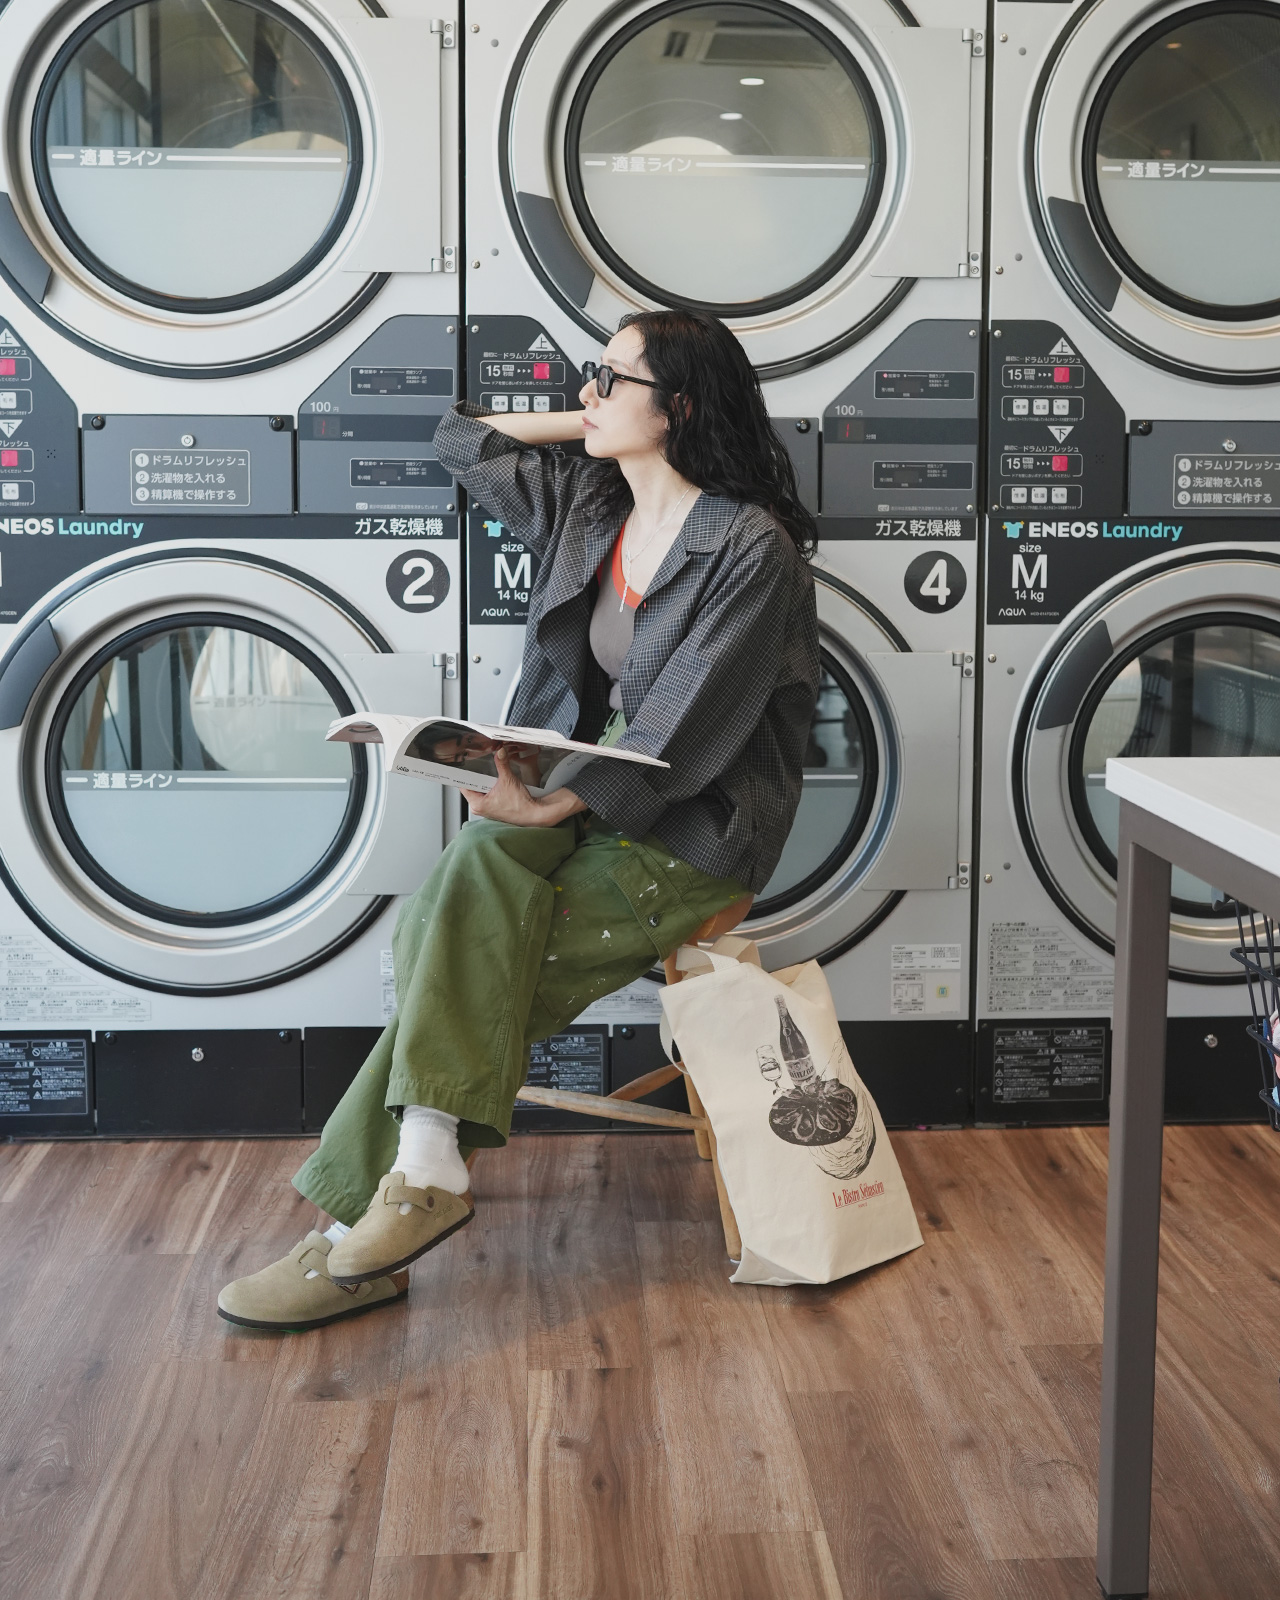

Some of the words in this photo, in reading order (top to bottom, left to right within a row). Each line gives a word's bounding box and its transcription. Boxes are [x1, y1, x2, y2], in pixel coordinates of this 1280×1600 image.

[80, 149, 163, 166] 適量ライン
[611, 156, 692, 172] 適量ライン
[1127, 161, 1205, 178] 適量ライン
[536, 337, 548, 349] 上
[1056, 341, 1069, 354] 上
[503, 352, 562, 360] ドラムリフレッシュ
[1024, 356, 1081, 364] ドラムリフレッシュ
[485, 364, 501, 377] 15
[1007, 368, 1022, 380] 15
[310, 401, 331, 413] 100
[835, 404, 856, 416] 100
[1055, 427, 1067, 441] 下
[1023, 445, 1079, 453] ドラムリフレッシュ
[152, 455, 246, 466] ドラムリフレッシュ
[1006, 457, 1021, 470] 15
[1194, 459, 1280, 471] ドラムリフレッシュ
[150, 472, 226, 484] 洗濯物を入れる
[1192, 476, 1263, 488] 洗濯物を入れる
[150, 489, 236, 500] 精算機で操作する
[1191, 492, 1273, 504] 精算機で操作する
[58, 517, 144, 539] Laundry
[355, 518, 443, 536] ガス乾燥機
[875, 519, 962, 537] ガス乾燥機
[1028, 521, 1099, 538] ENEOS
[1102, 522, 1183, 542] Laundry
[500, 542, 524, 553] size
[1018, 542, 1042, 553] size
[494, 553, 531, 589] M
[1011, 554, 1047, 589] M
[401, 557, 435, 605] 2
[919, 558, 951, 606] 4
[497, 590, 511, 600] 14
[514, 590, 528, 602] kg
[1014, 590, 1027, 600] 14
[1030, 590, 1044, 603] kg
[481, 608, 510, 616] AQUA
[998, 608, 1027, 616] AQUA
[92, 772, 173, 789] 適量ライン
